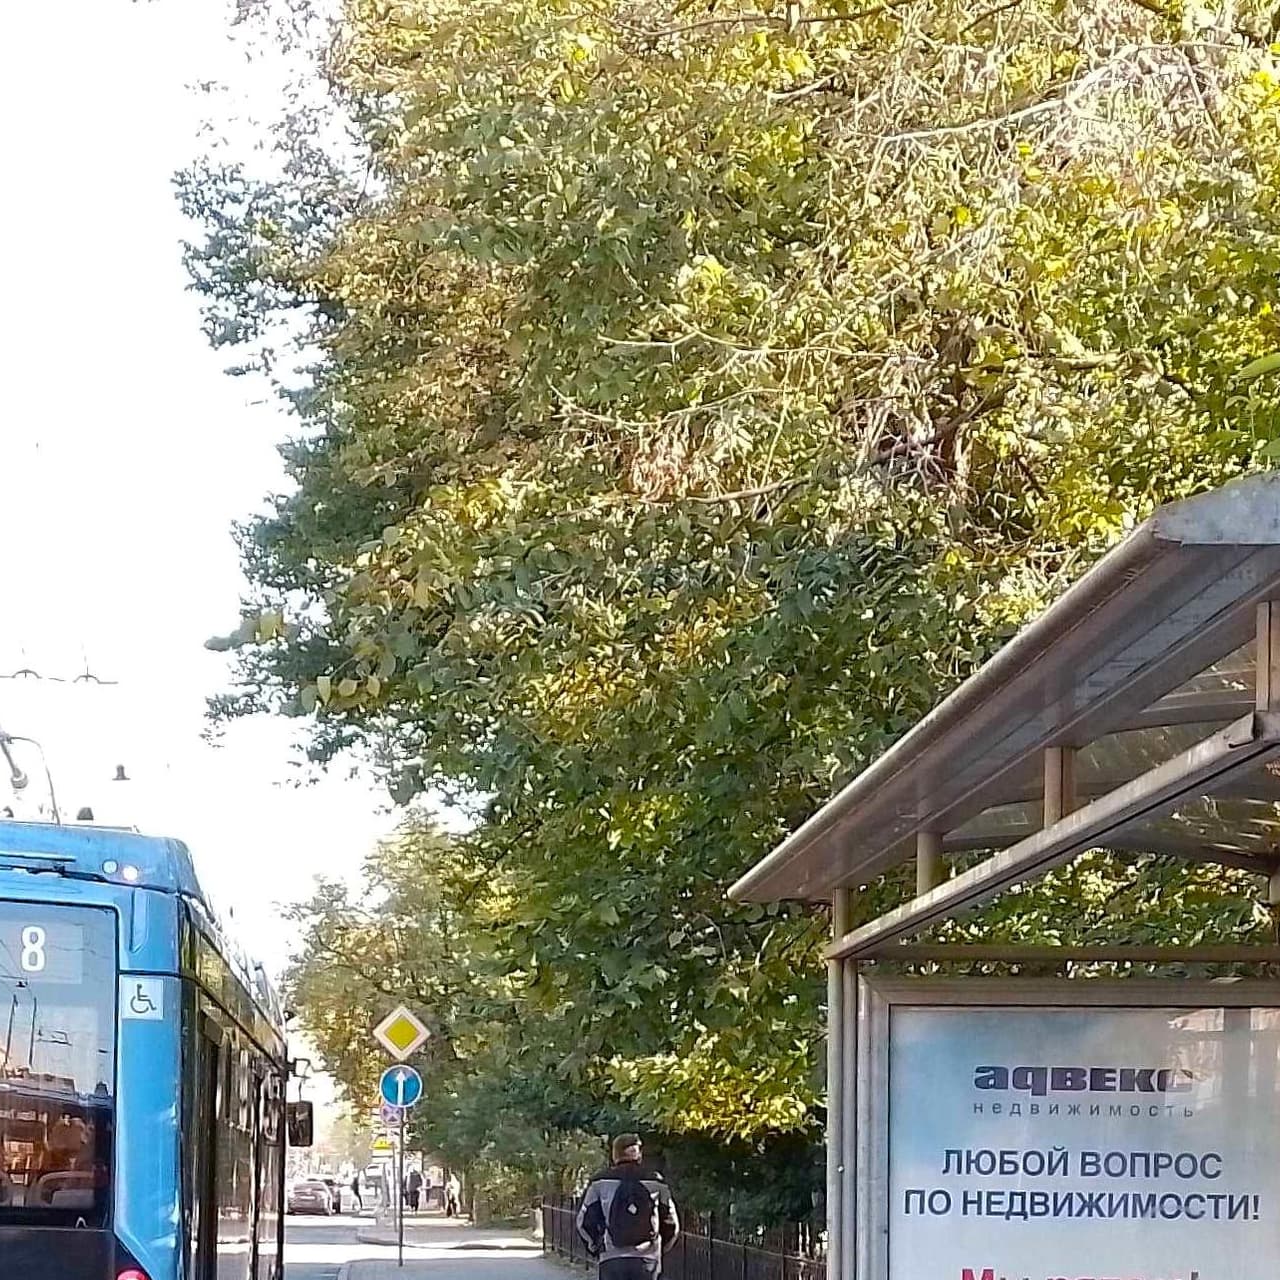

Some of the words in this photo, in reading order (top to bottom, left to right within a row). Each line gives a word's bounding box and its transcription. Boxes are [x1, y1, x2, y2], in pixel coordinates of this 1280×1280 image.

[21, 925, 46, 972] 8
[972, 1102, 1194, 1118] недвижимость
[941, 1145, 1069, 1176] ЛЮБОЙ
[1080, 1150, 1223, 1179] ВОПРОС
[904, 1189, 952, 1216] ПО
[961, 1190, 1260, 1221] НЕДВИЖИМОСТИ!
